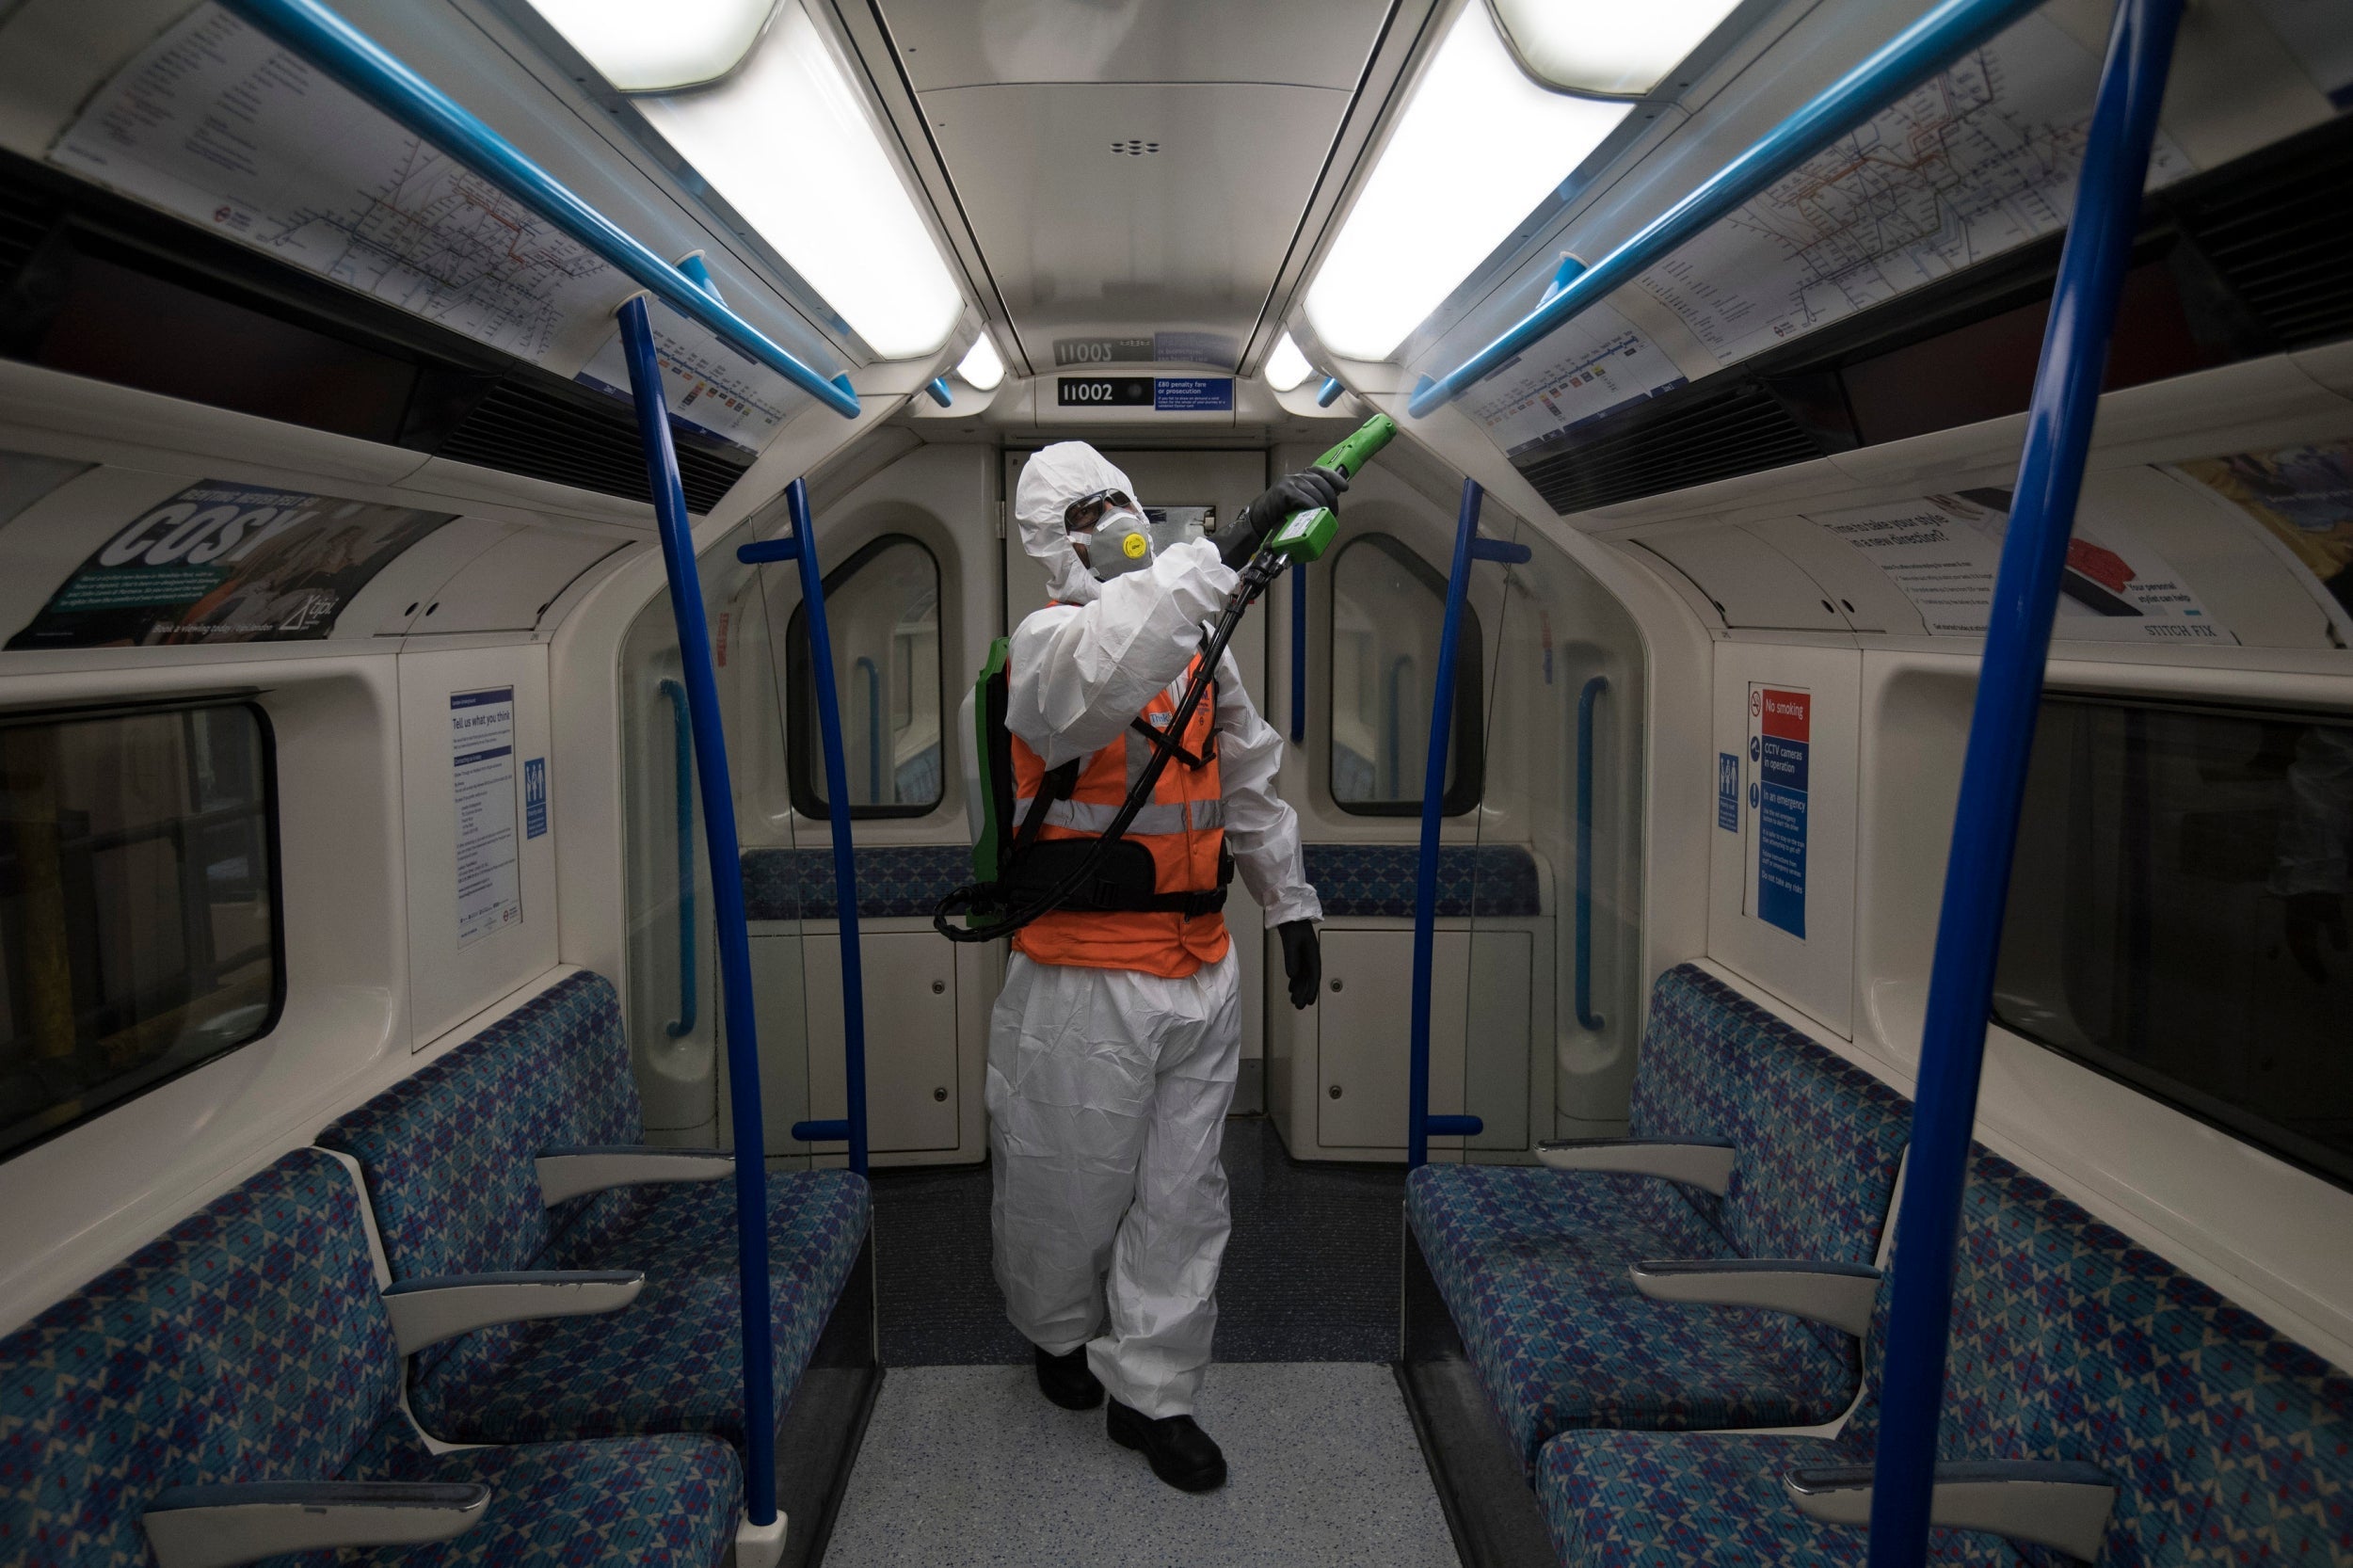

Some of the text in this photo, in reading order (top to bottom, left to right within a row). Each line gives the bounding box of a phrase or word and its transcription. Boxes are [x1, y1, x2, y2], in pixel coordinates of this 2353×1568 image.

[1063, 384, 1112, 400] 11002
[1825, 524, 1858, 533] Time
[1865, 520, 1893, 529] take
[1890, 519, 1919, 530] your
[1914, 513, 1948, 527] style
[100, 502, 320, 567] COSY
[1868, 537, 1894, 546] new
[1888, 529, 1949, 545] direction?
[2145, 582, 2177, 592] personal
[2138, 594, 2160, 604] stylist
[2145, 625, 2217, 637] STITCH FIX
[1765, 698, 1804, 720] No smoking
[453, 710, 510, 729] Tell us what you think
[1764, 743, 1803, 761] CCTV cameras
[1764, 756, 1795, 774] in operation
[1763, 789, 1805, 814] In an emergency
[1761, 869, 1767, 880] Do
[1775, 876, 1783, 887] take
[1792, 882, 1802, 894] risks
